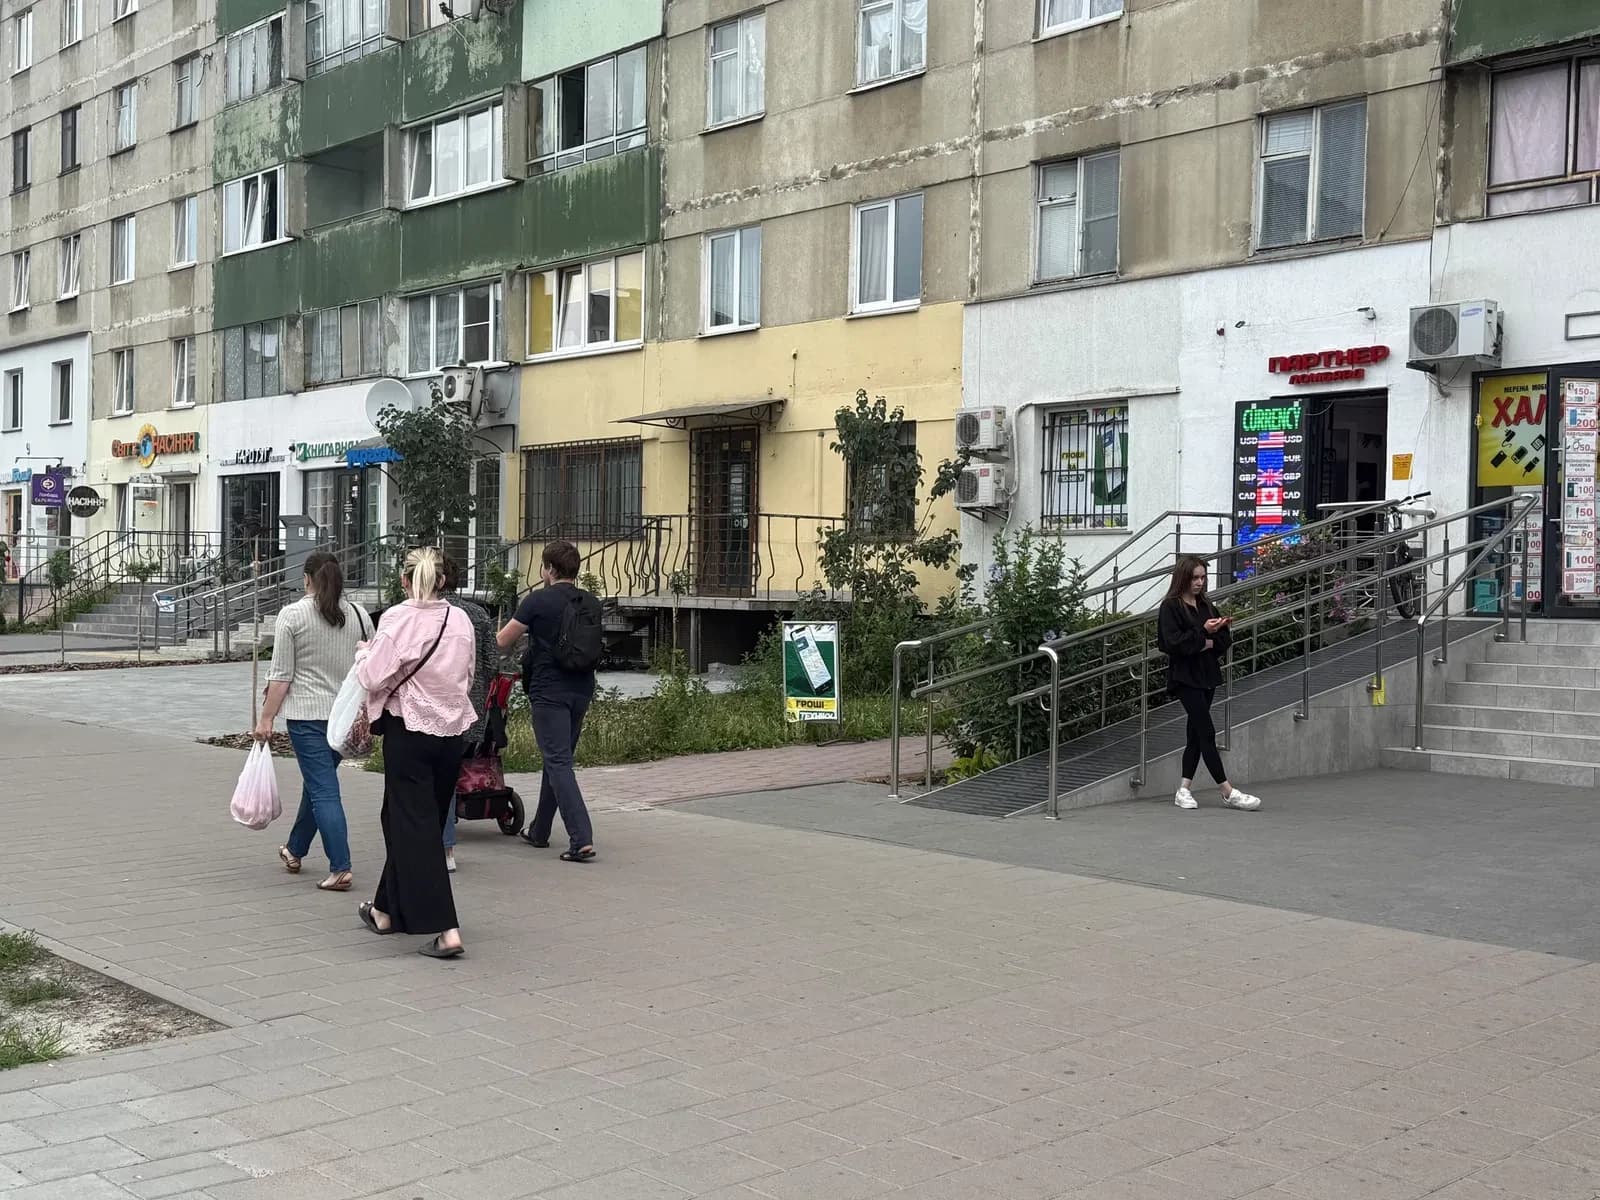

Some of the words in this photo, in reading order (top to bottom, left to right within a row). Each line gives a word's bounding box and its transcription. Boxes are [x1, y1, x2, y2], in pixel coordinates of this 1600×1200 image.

[1268, 345, 1389, 373] ПАРТНЕР
[1243, 407, 1301, 431] CURRENCY
[1577, 418, 1596, 428] 200
[153, 432, 199, 455] НАСІННЯ
[1240, 436, 1258, 445] USD
[1284, 434, 1303, 443] USD
[1239, 474, 1257, 482] GBP
[1284, 472, 1302, 480] GBP
[1579, 485, 1594, 495] 100
[1239, 492, 1256, 501] CAD
[1283, 491, 1301, 499] CAD
[68, 496, 104, 507] НАСІННЯ
[1580, 507, 1593, 517] 50
[1582, 530, 1593, 539] 50
[1575, 555, 1594, 565] 100
[796, 700, 824, 708] ГРОШІ
